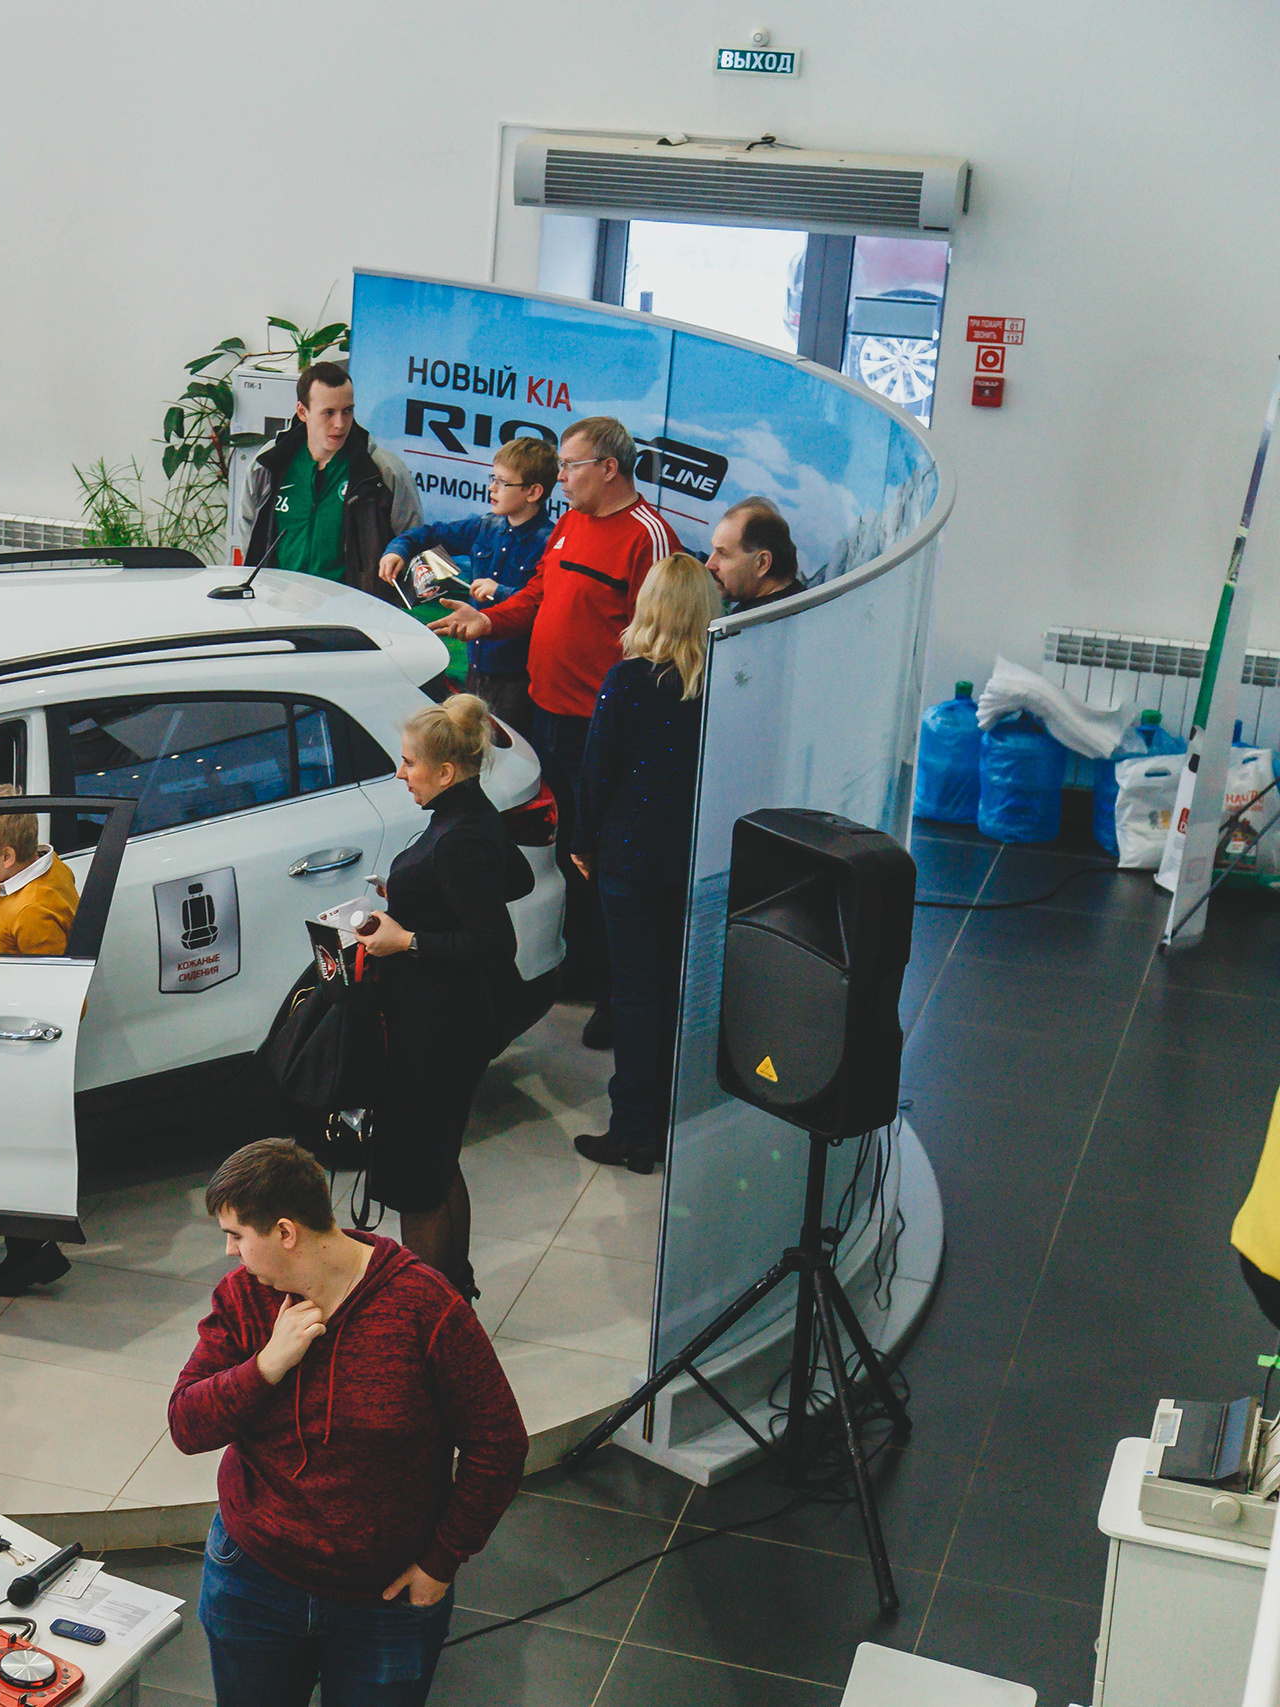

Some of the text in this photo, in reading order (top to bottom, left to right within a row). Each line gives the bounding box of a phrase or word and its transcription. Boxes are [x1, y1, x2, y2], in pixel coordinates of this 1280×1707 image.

[720, 50, 792, 73] ВЫХОД
[407, 355, 573, 412] НОВЫЙ KIA
[661, 463, 718, 494] LINE
[275, 495, 290, 512] 26
[177, 953, 221, 971] КОЖАНЫЕ
[178, 965, 219, 982] СИДЕНИЯ
